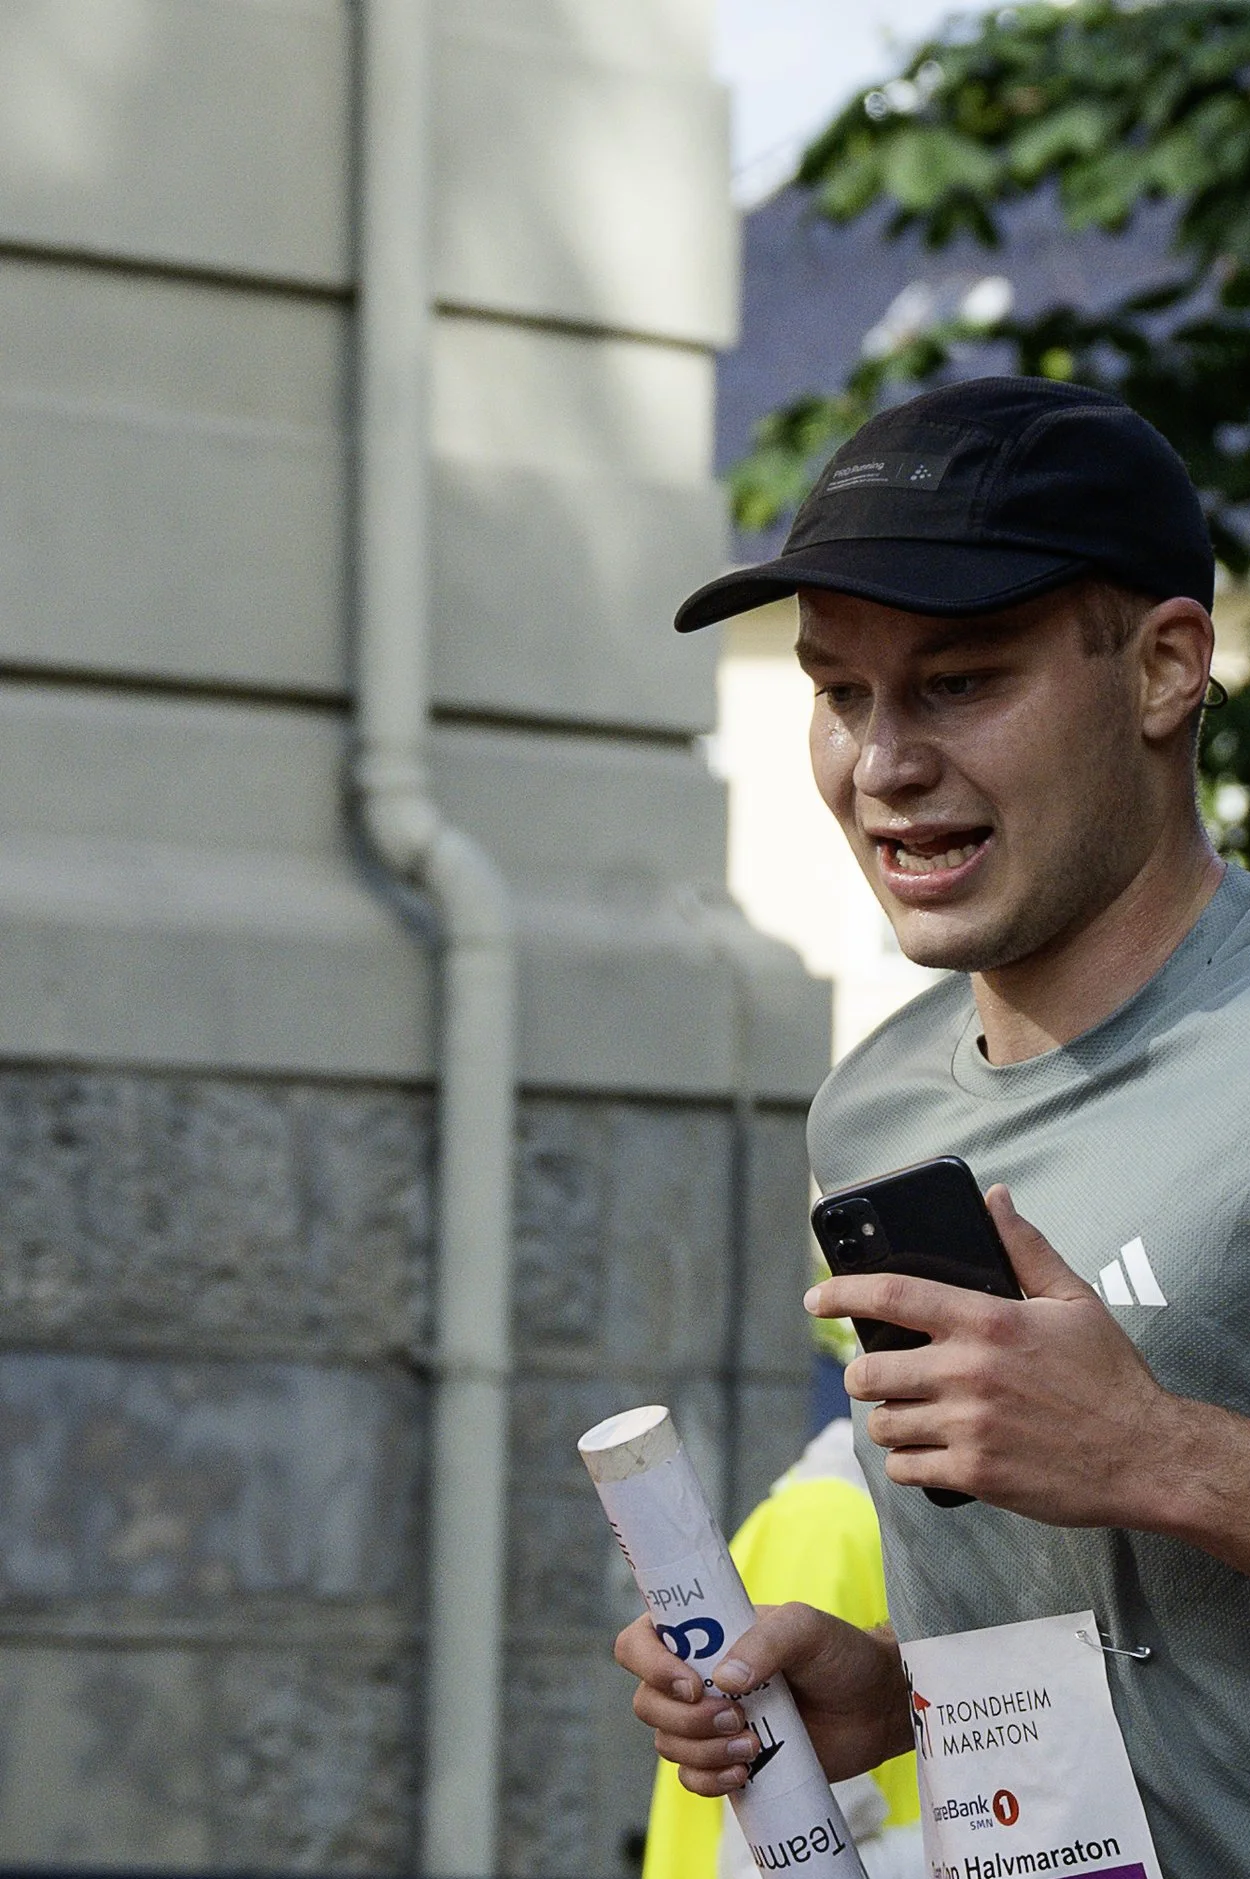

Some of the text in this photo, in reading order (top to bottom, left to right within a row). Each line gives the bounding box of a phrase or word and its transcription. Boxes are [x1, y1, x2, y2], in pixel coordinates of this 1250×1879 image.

[654, 1617, 725, 1662] co
[936, 1687, 1052, 1726] TRONDHEIM
[943, 1720, 1039, 1757] MARATON
[970, 1817, 994, 1831] SMN
